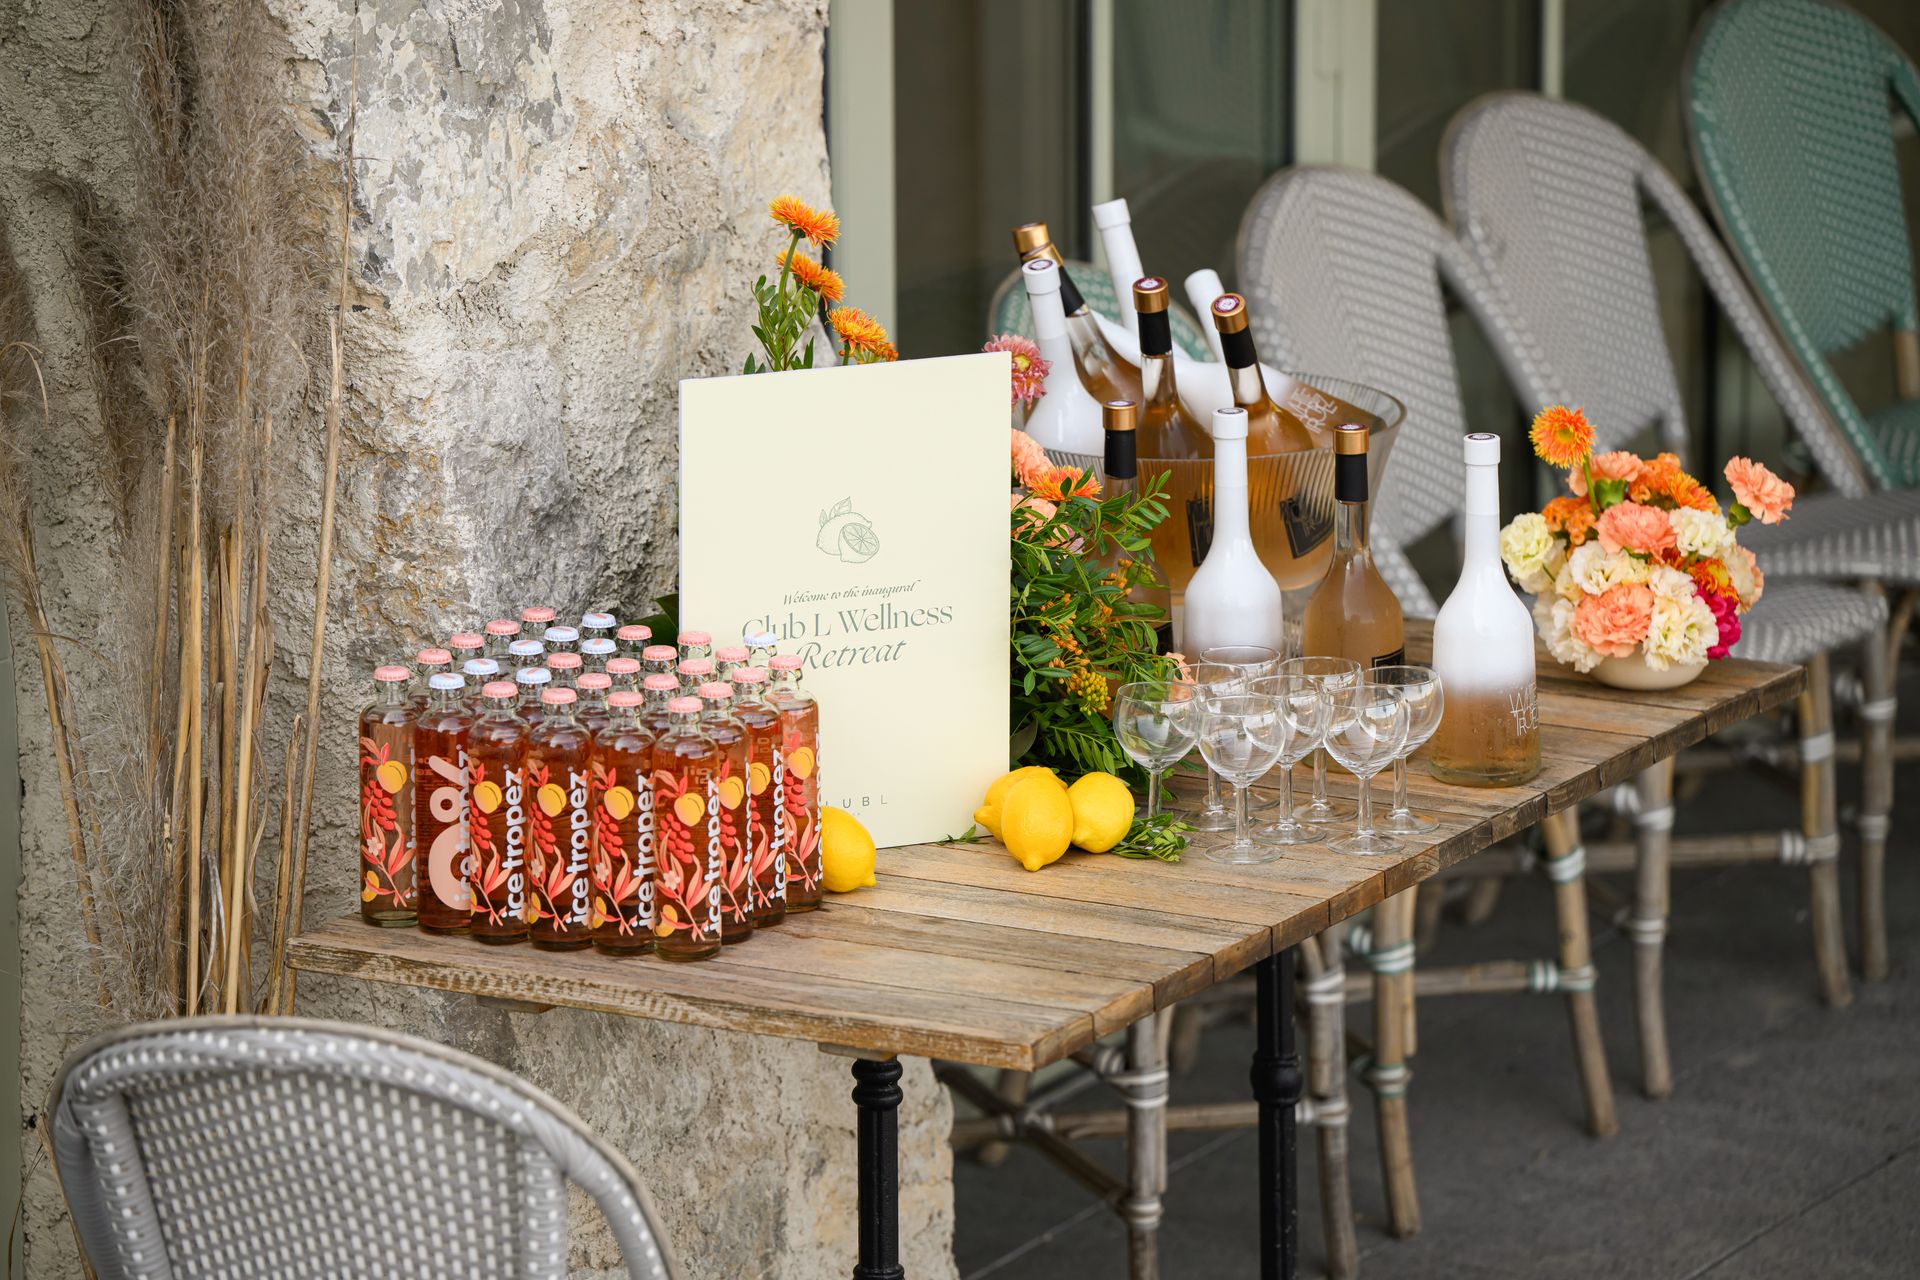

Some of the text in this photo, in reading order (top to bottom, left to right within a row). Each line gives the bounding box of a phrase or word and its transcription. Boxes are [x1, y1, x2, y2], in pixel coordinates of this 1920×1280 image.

[783, 579, 921, 606] Welcome to the inaugural
[742, 602, 953, 641] Club L Wellness
[796, 639, 907, 670] Retreat
[501, 767, 526, 919] ice tropez
[565, 769, 591, 924] ice tropez
[631, 772, 655, 928] ice tropez
[704, 884, 721, 933] ice
